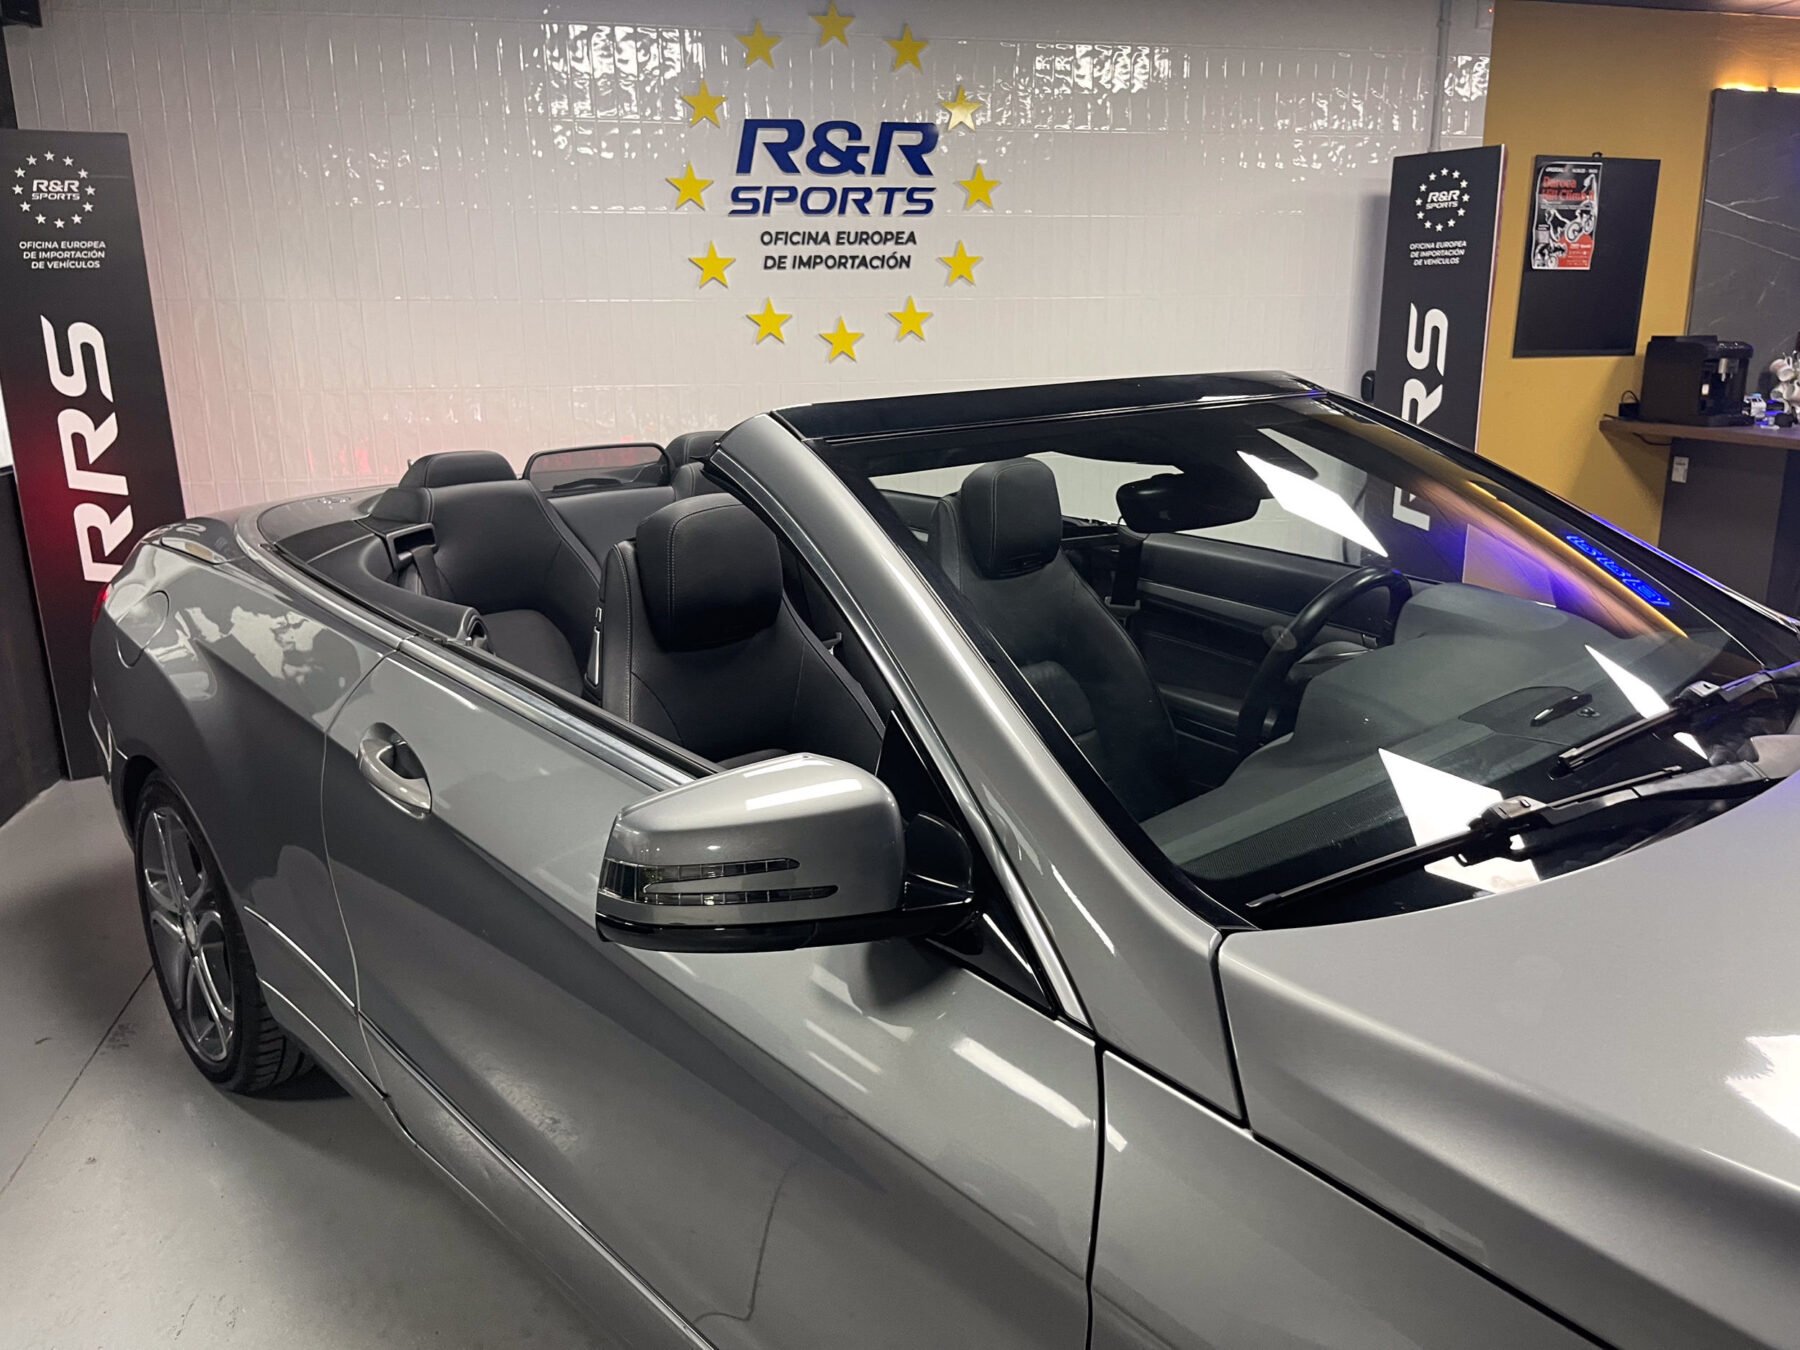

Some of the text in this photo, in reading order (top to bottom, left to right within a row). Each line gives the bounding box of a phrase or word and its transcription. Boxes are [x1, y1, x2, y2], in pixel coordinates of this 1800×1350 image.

[736, 118, 939, 176] R&R
[32, 179, 80, 193] R&R
[31, 192, 80, 200] SPORTS
[727, 186, 937, 216] SPORTS
[1427, 189, 1461, 203] R&R
[1425, 201, 1459, 210] SPORTS
[760, 230, 917, 246] OFICINA EUROPEA
[19, 240, 106, 250] OFICINA EUROPEA
[1409, 240, 1467, 250] OFICINA EUROPEA
[23, 249, 106, 259] DE IMPORTACIÓN
[1410, 250, 1419, 258] DE
[31, 260, 101, 269] DE VEHÍCULOS
[763, 251, 912, 270] DE IMPORTACIÓN
[1413, 258, 1423, 266] DE
[40, 314, 134, 583] RRS
